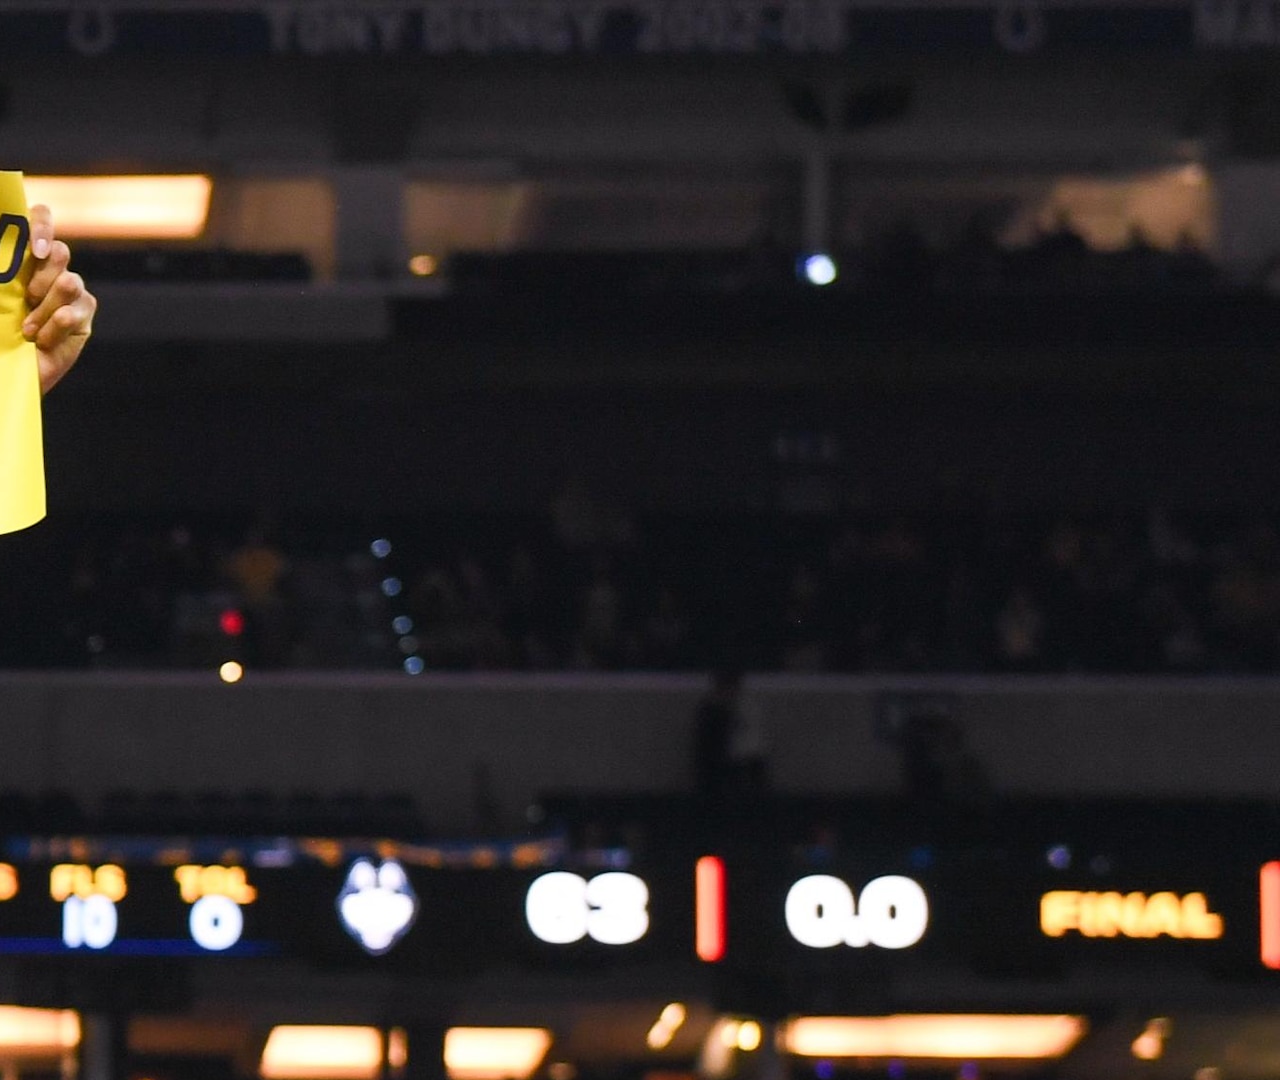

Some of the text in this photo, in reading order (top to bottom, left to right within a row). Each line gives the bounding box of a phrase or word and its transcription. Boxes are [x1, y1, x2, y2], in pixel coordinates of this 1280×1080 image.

[63, 894, 117, 948] 10
[189, 894, 243, 950] 0
[525, 871, 650, 944] 63
[785, 875, 928, 948] 0.0
[1040, 890, 1223, 939] FINAL
